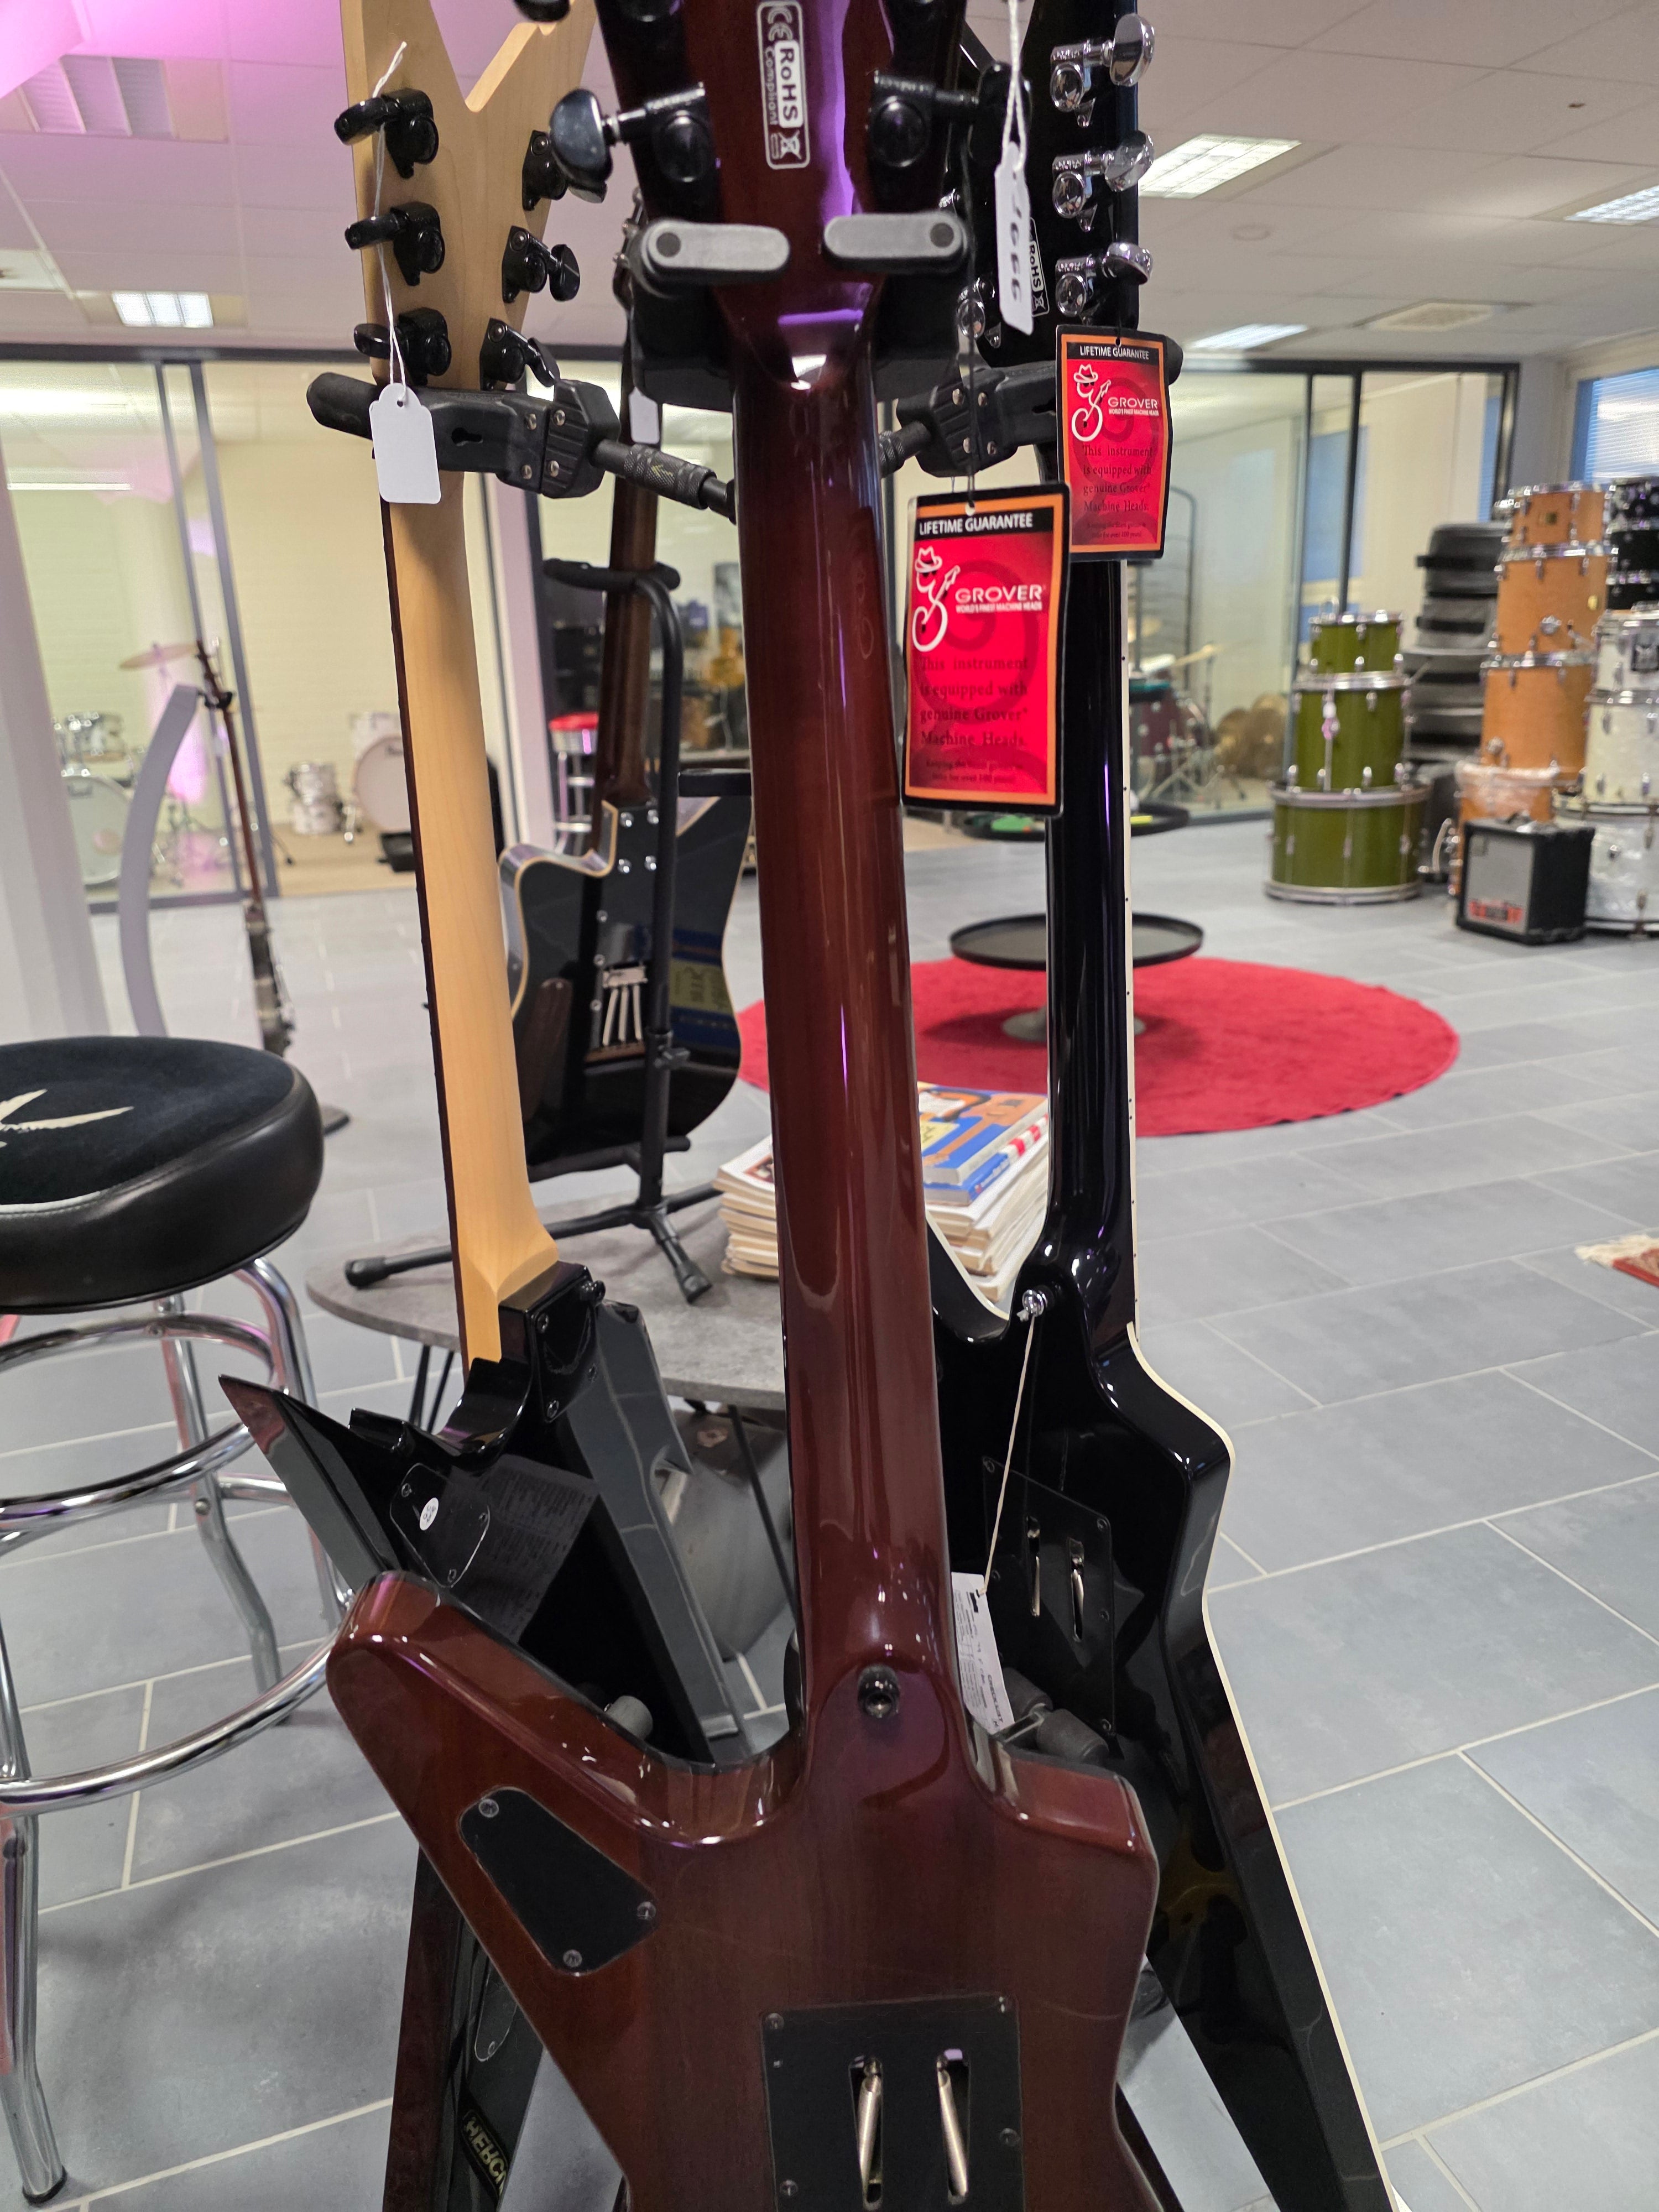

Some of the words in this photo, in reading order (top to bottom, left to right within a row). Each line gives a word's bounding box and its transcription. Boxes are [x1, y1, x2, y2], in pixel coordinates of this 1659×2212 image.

[780, 48, 798, 121] RoHS
[1030, 244, 1041, 288] RoHS
[1080, 345, 1111, 357] LIFETIME
[1113, 347, 1149, 359] GUARANTEE
[1108, 397, 1157, 409] GROVER
[1083, 445, 1102, 456] This
[1108, 445, 1152, 457] instrument
[1083, 465, 1089, 474] is
[1093, 463, 1132, 478] equipped
[1134, 463, 1151, 474] with
[1083, 483, 1117, 495] genuine
[1084, 499, 1120, 512] Machine
[919, 518, 963, 535] LIFETIME
[965, 512, 1033, 533] GUARANTEE
[955, 584, 1042, 603] GROVER
[921, 656, 945, 670] This
[953, 656, 1028, 670] instrument
[932, 680, 993, 700] equipped
[998, 681, 1027, 696] with
[920, 707, 969, 724] genuine
[921, 730, 975, 745] Machine
